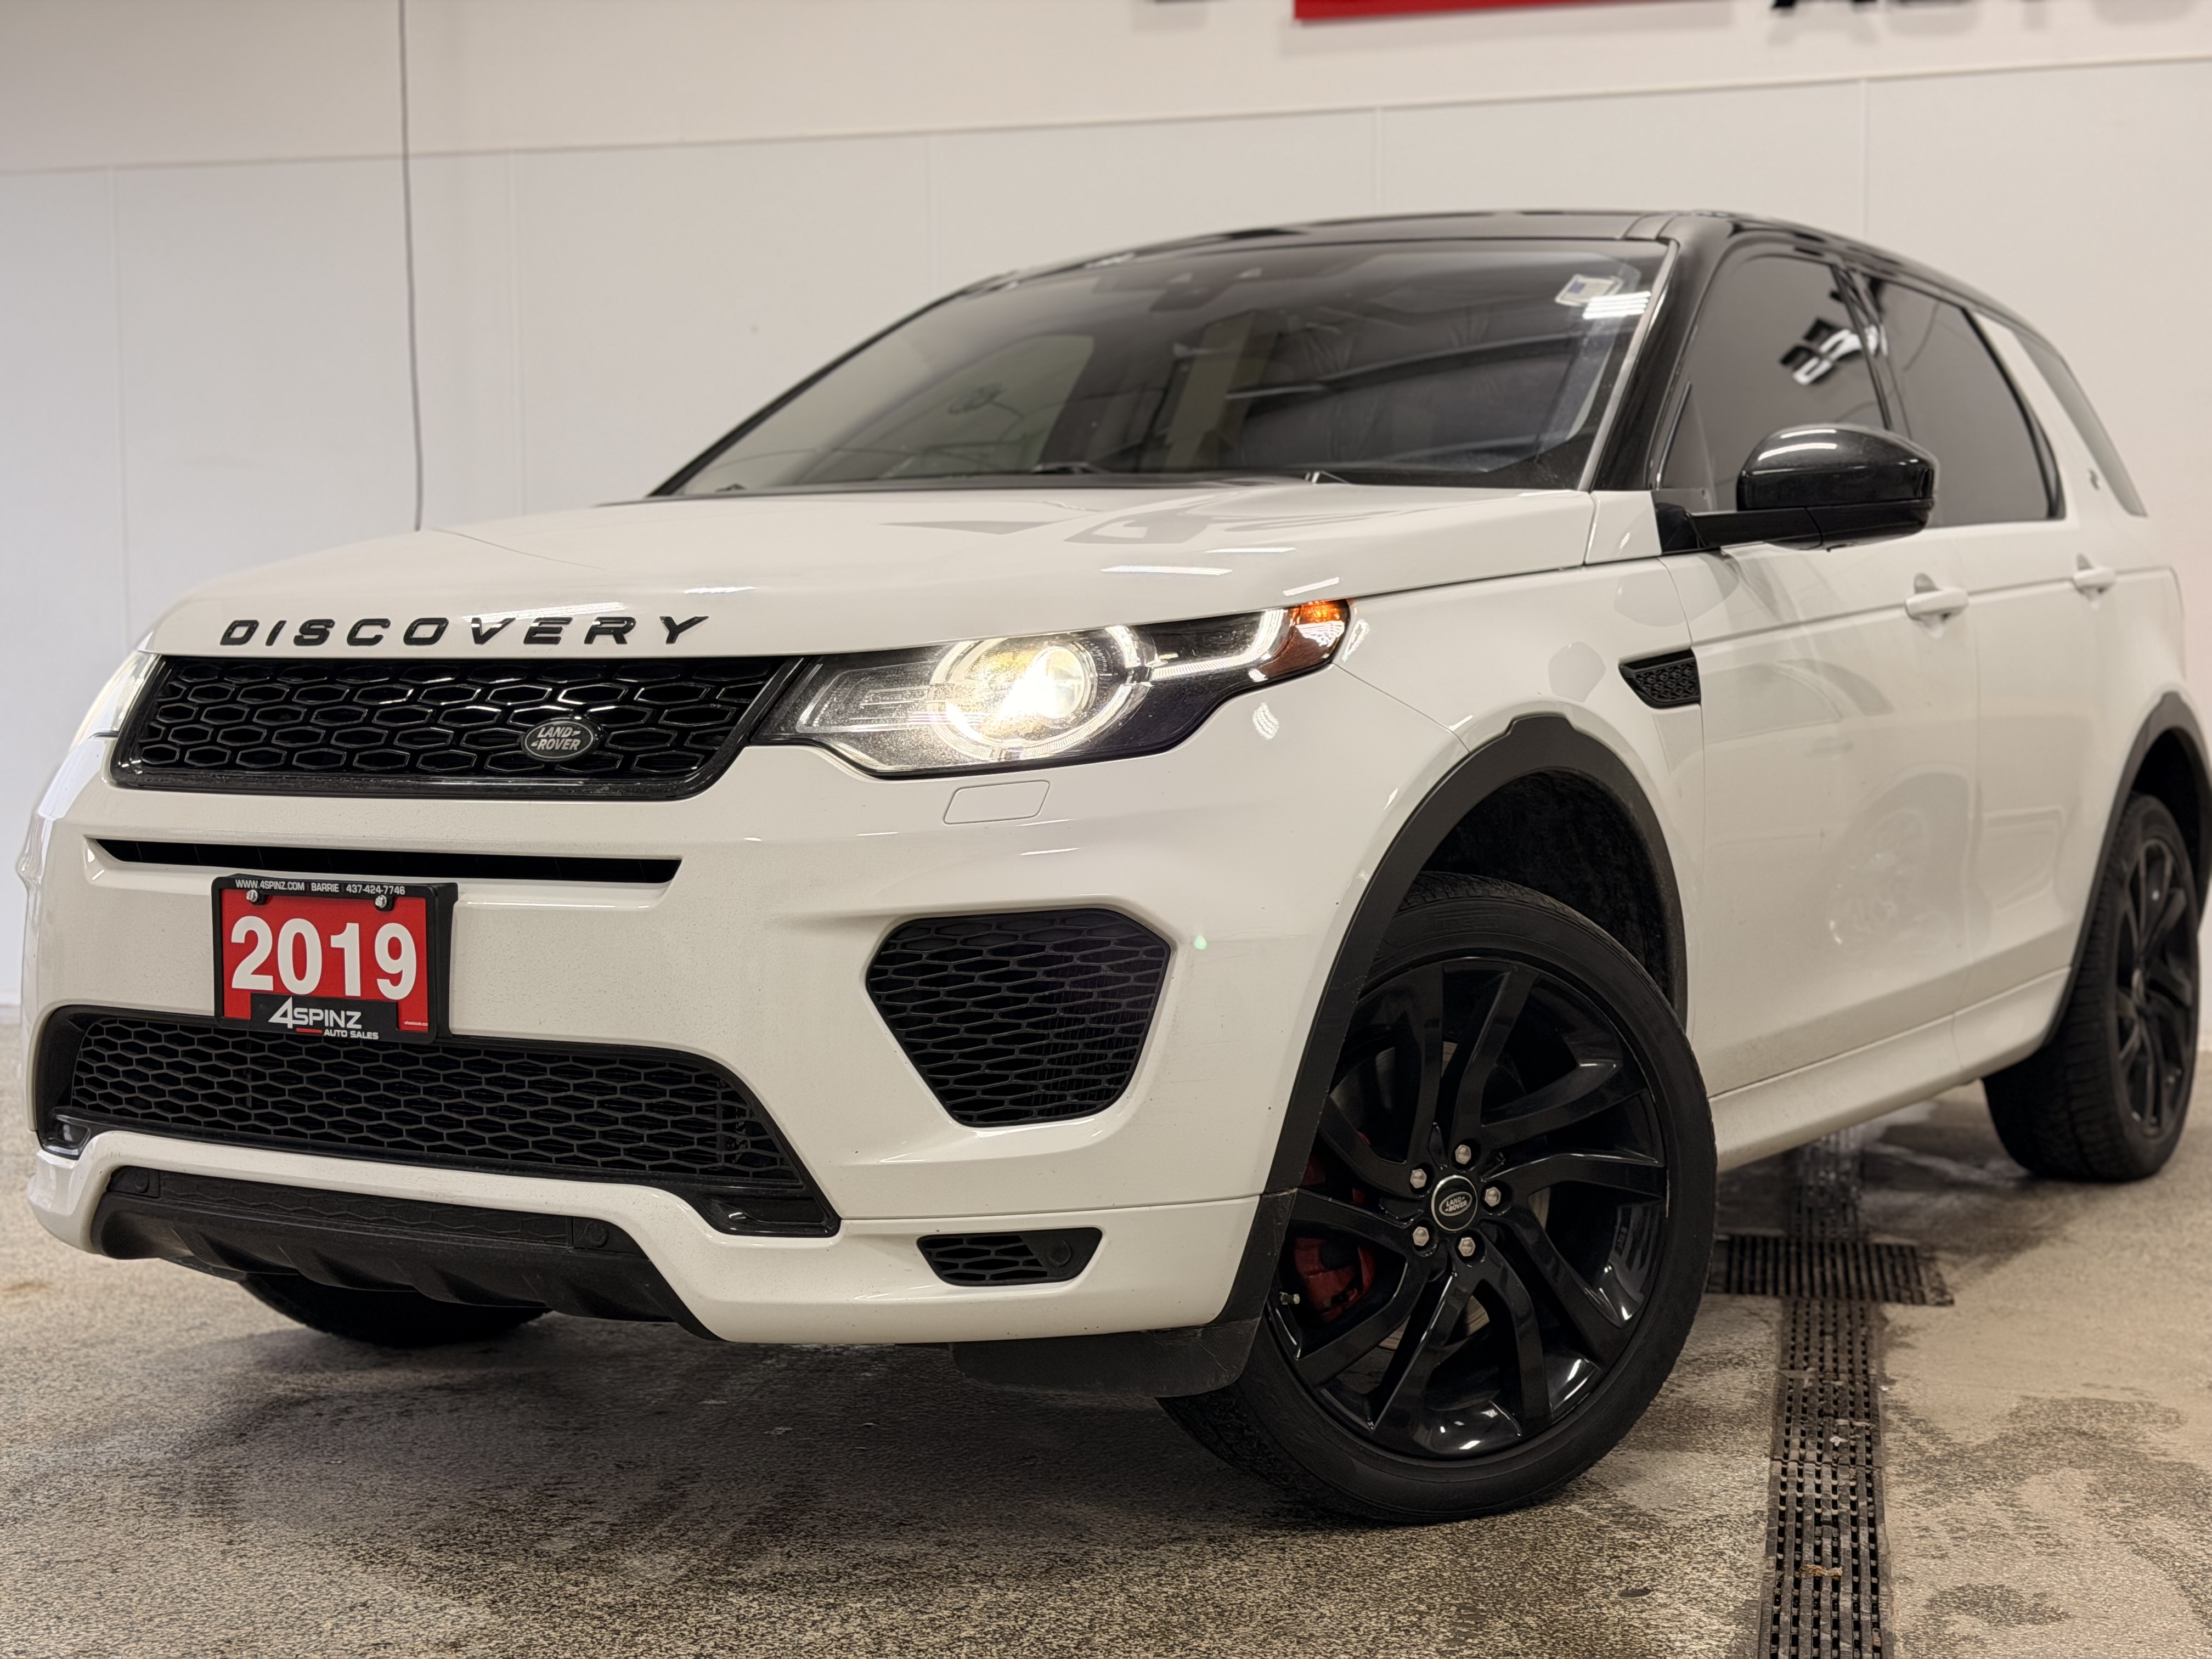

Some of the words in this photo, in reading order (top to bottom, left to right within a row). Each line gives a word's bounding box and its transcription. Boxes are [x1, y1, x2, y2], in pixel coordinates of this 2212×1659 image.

[220, 616, 709, 646] DISCOVERY
[537, 726, 573, 738] LAND
[537, 738, 581, 751] ROVER
[235, 879, 305, 891] WWW.4SPINZ.COM
[311, 883, 340, 893] BARRIE
[346, 886, 405, 895] 437-424-7746
[231, 916, 417, 1000] 2019
[268, 996, 362, 1029] 4SPINZ
[324, 1029, 347, 1037] AUTO
[350, 1030, 379, 1040] SALES
[1446, 1197, 1462, 1207] LAND
[1448, 1200, 1468, 1212] ROVER
